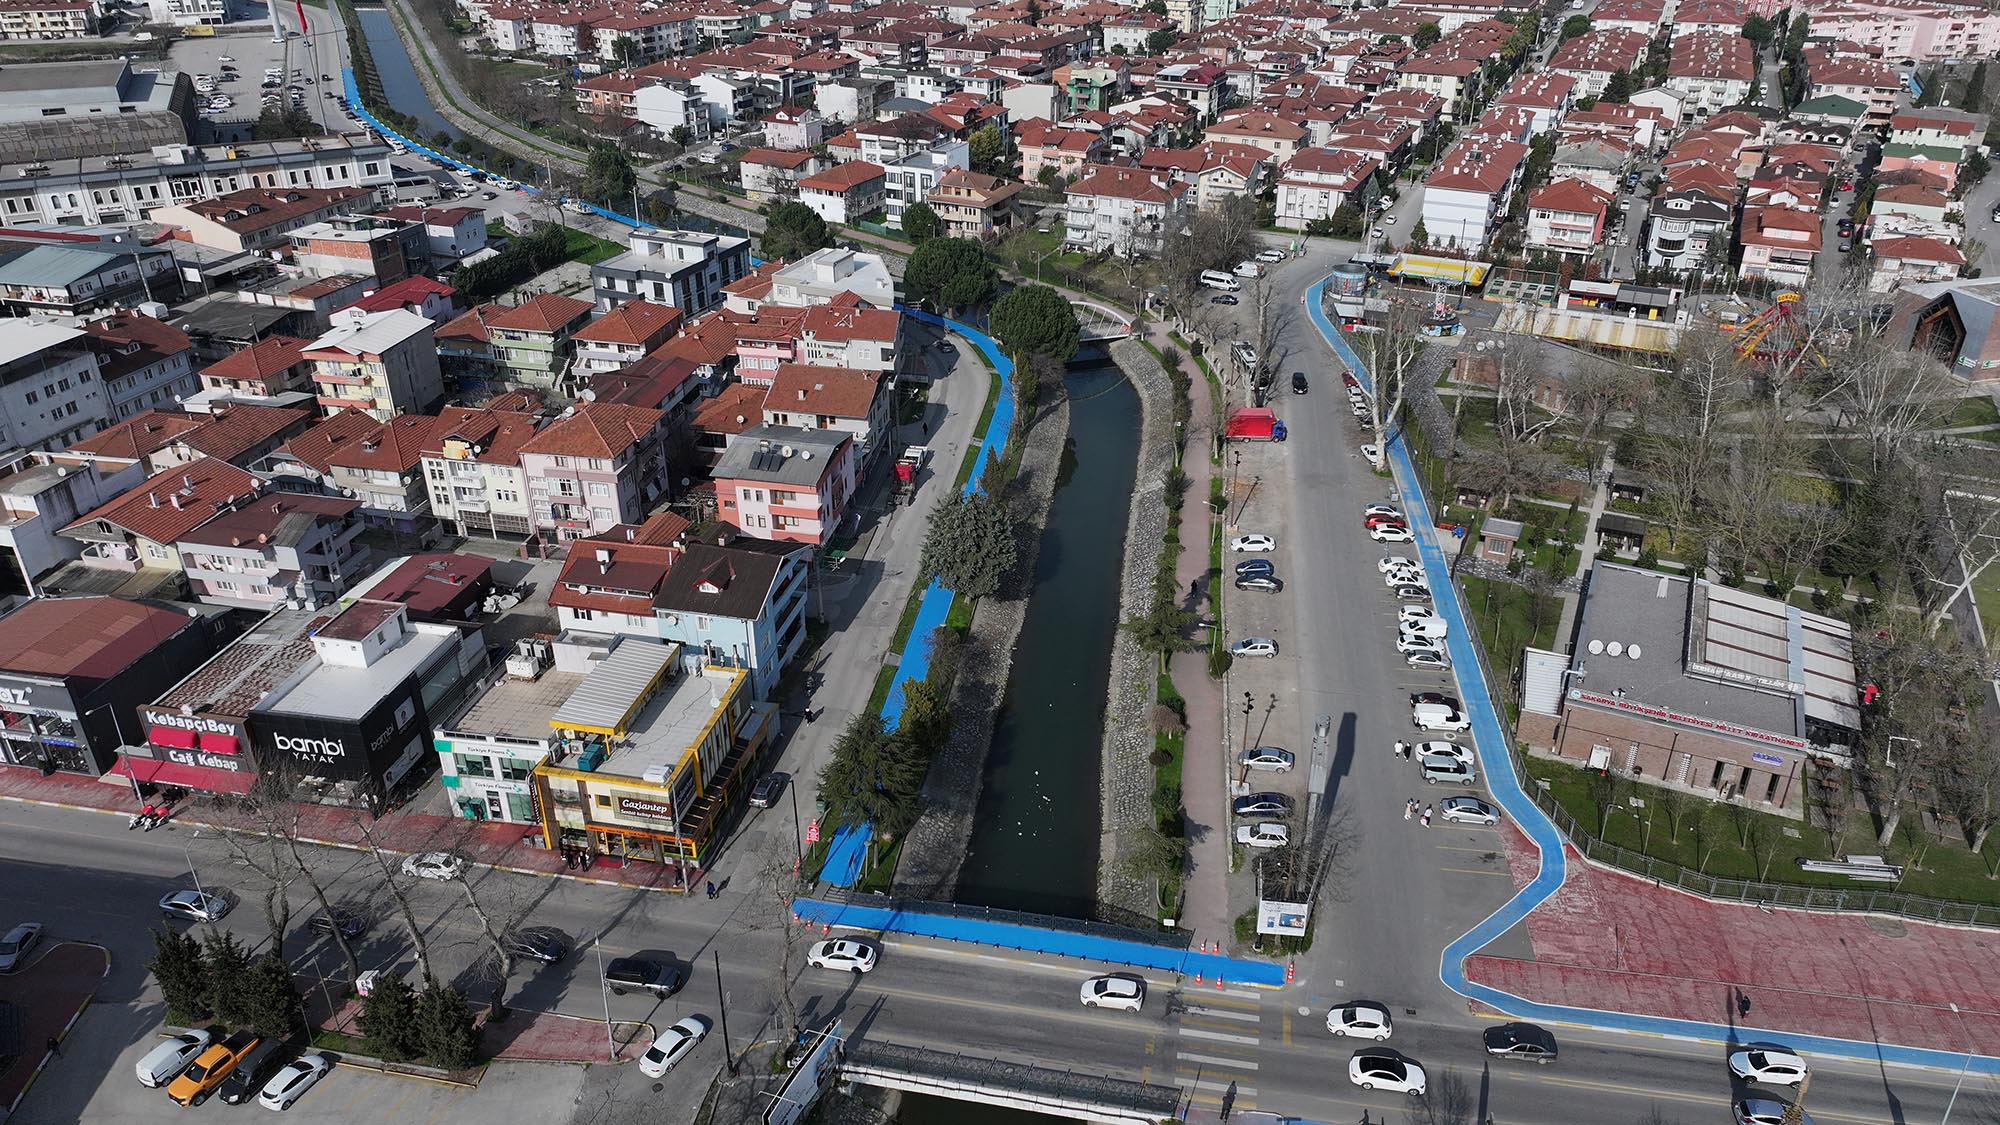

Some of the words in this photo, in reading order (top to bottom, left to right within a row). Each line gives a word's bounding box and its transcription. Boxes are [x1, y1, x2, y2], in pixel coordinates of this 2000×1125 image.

[145, 710, 236, 736] KebapçıBey
[1582, 694, 1616, 706] SAKARYA
[1669, 712, 1713, 728] BELEDİYESİ
[1715, 723, 1744, 734] MİLLET
[1745, 731, 1805, 748] KIRAATHANESİ
[273, 732, 346, 757] bambi
[197, 753, 239, 772] Kebap
[293, 752, 335, 764] YATAK
[622, 799, 668, 814] Gaziantep
